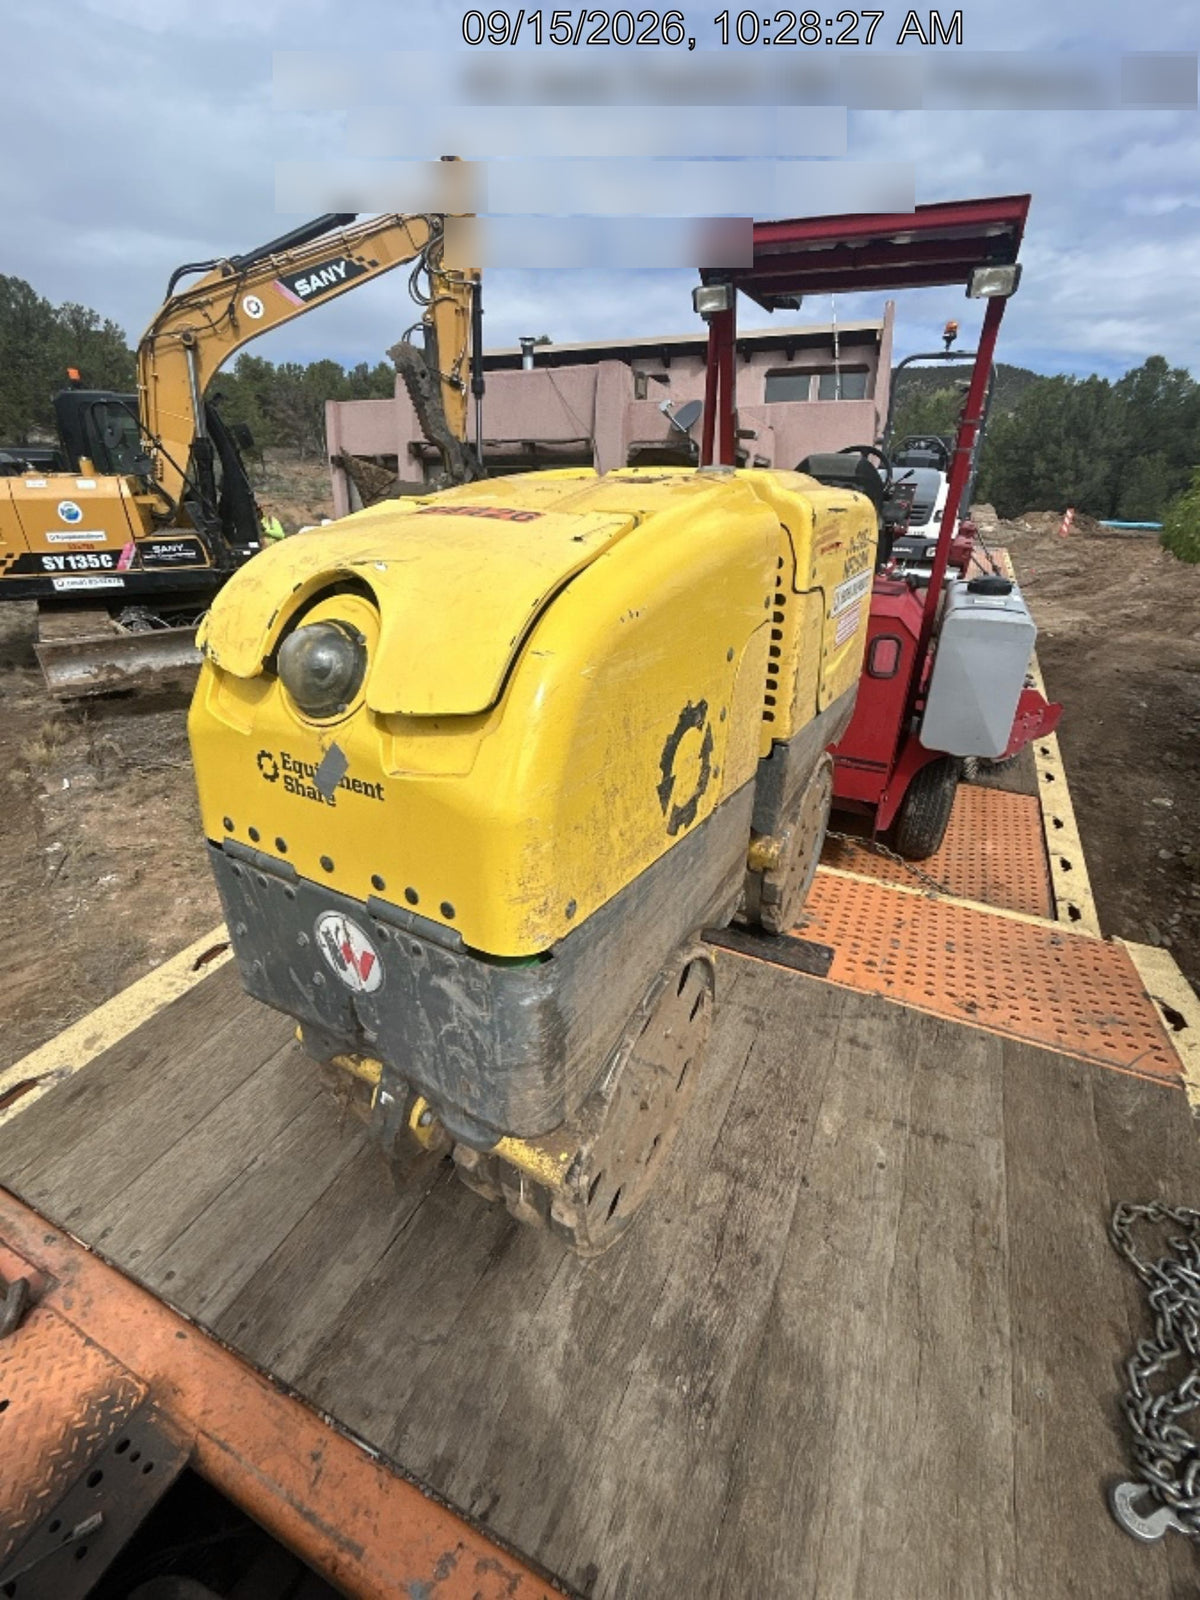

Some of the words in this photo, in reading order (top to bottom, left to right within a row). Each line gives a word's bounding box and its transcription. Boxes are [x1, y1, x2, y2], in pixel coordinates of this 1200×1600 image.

[294, 261, 346, 297] SANY
[42, 552, 113, 570] SY135C
[152, 544, 184, 554] SANY
[280, 751, 385, 801] Equiment
